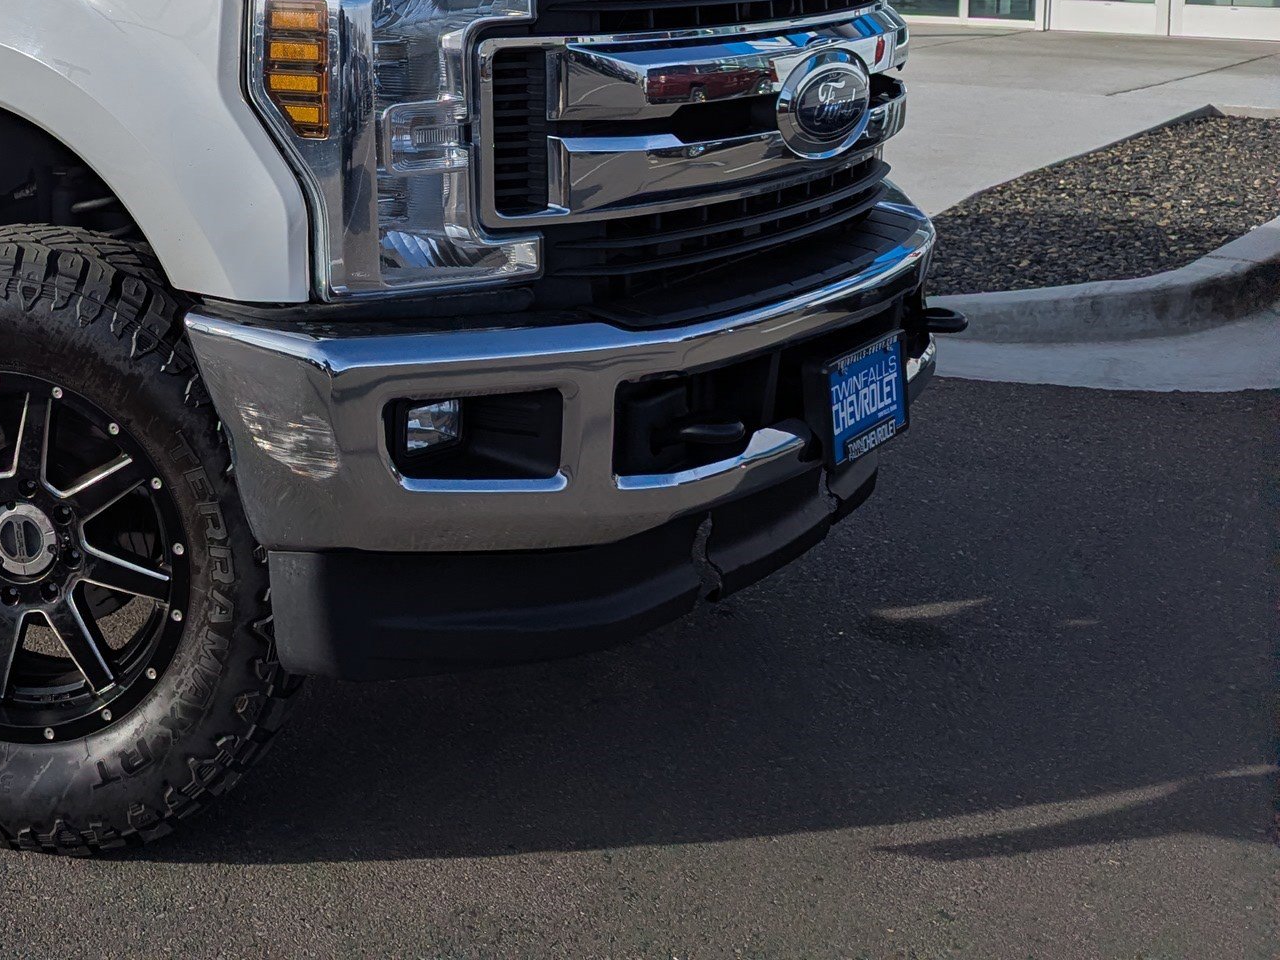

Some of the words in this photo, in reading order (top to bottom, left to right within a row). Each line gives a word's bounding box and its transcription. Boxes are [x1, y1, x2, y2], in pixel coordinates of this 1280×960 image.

[814, 80, 858, 126] Ford
[831, 355, 897, 404] TWINFALLS
[832, 372, 898, 436] CHEVROLET
[863, 419, 897, 452] CHEVROLET
[159, 428, 236, 746] TERRAMAX
[93, 737, 156, 791] RT
